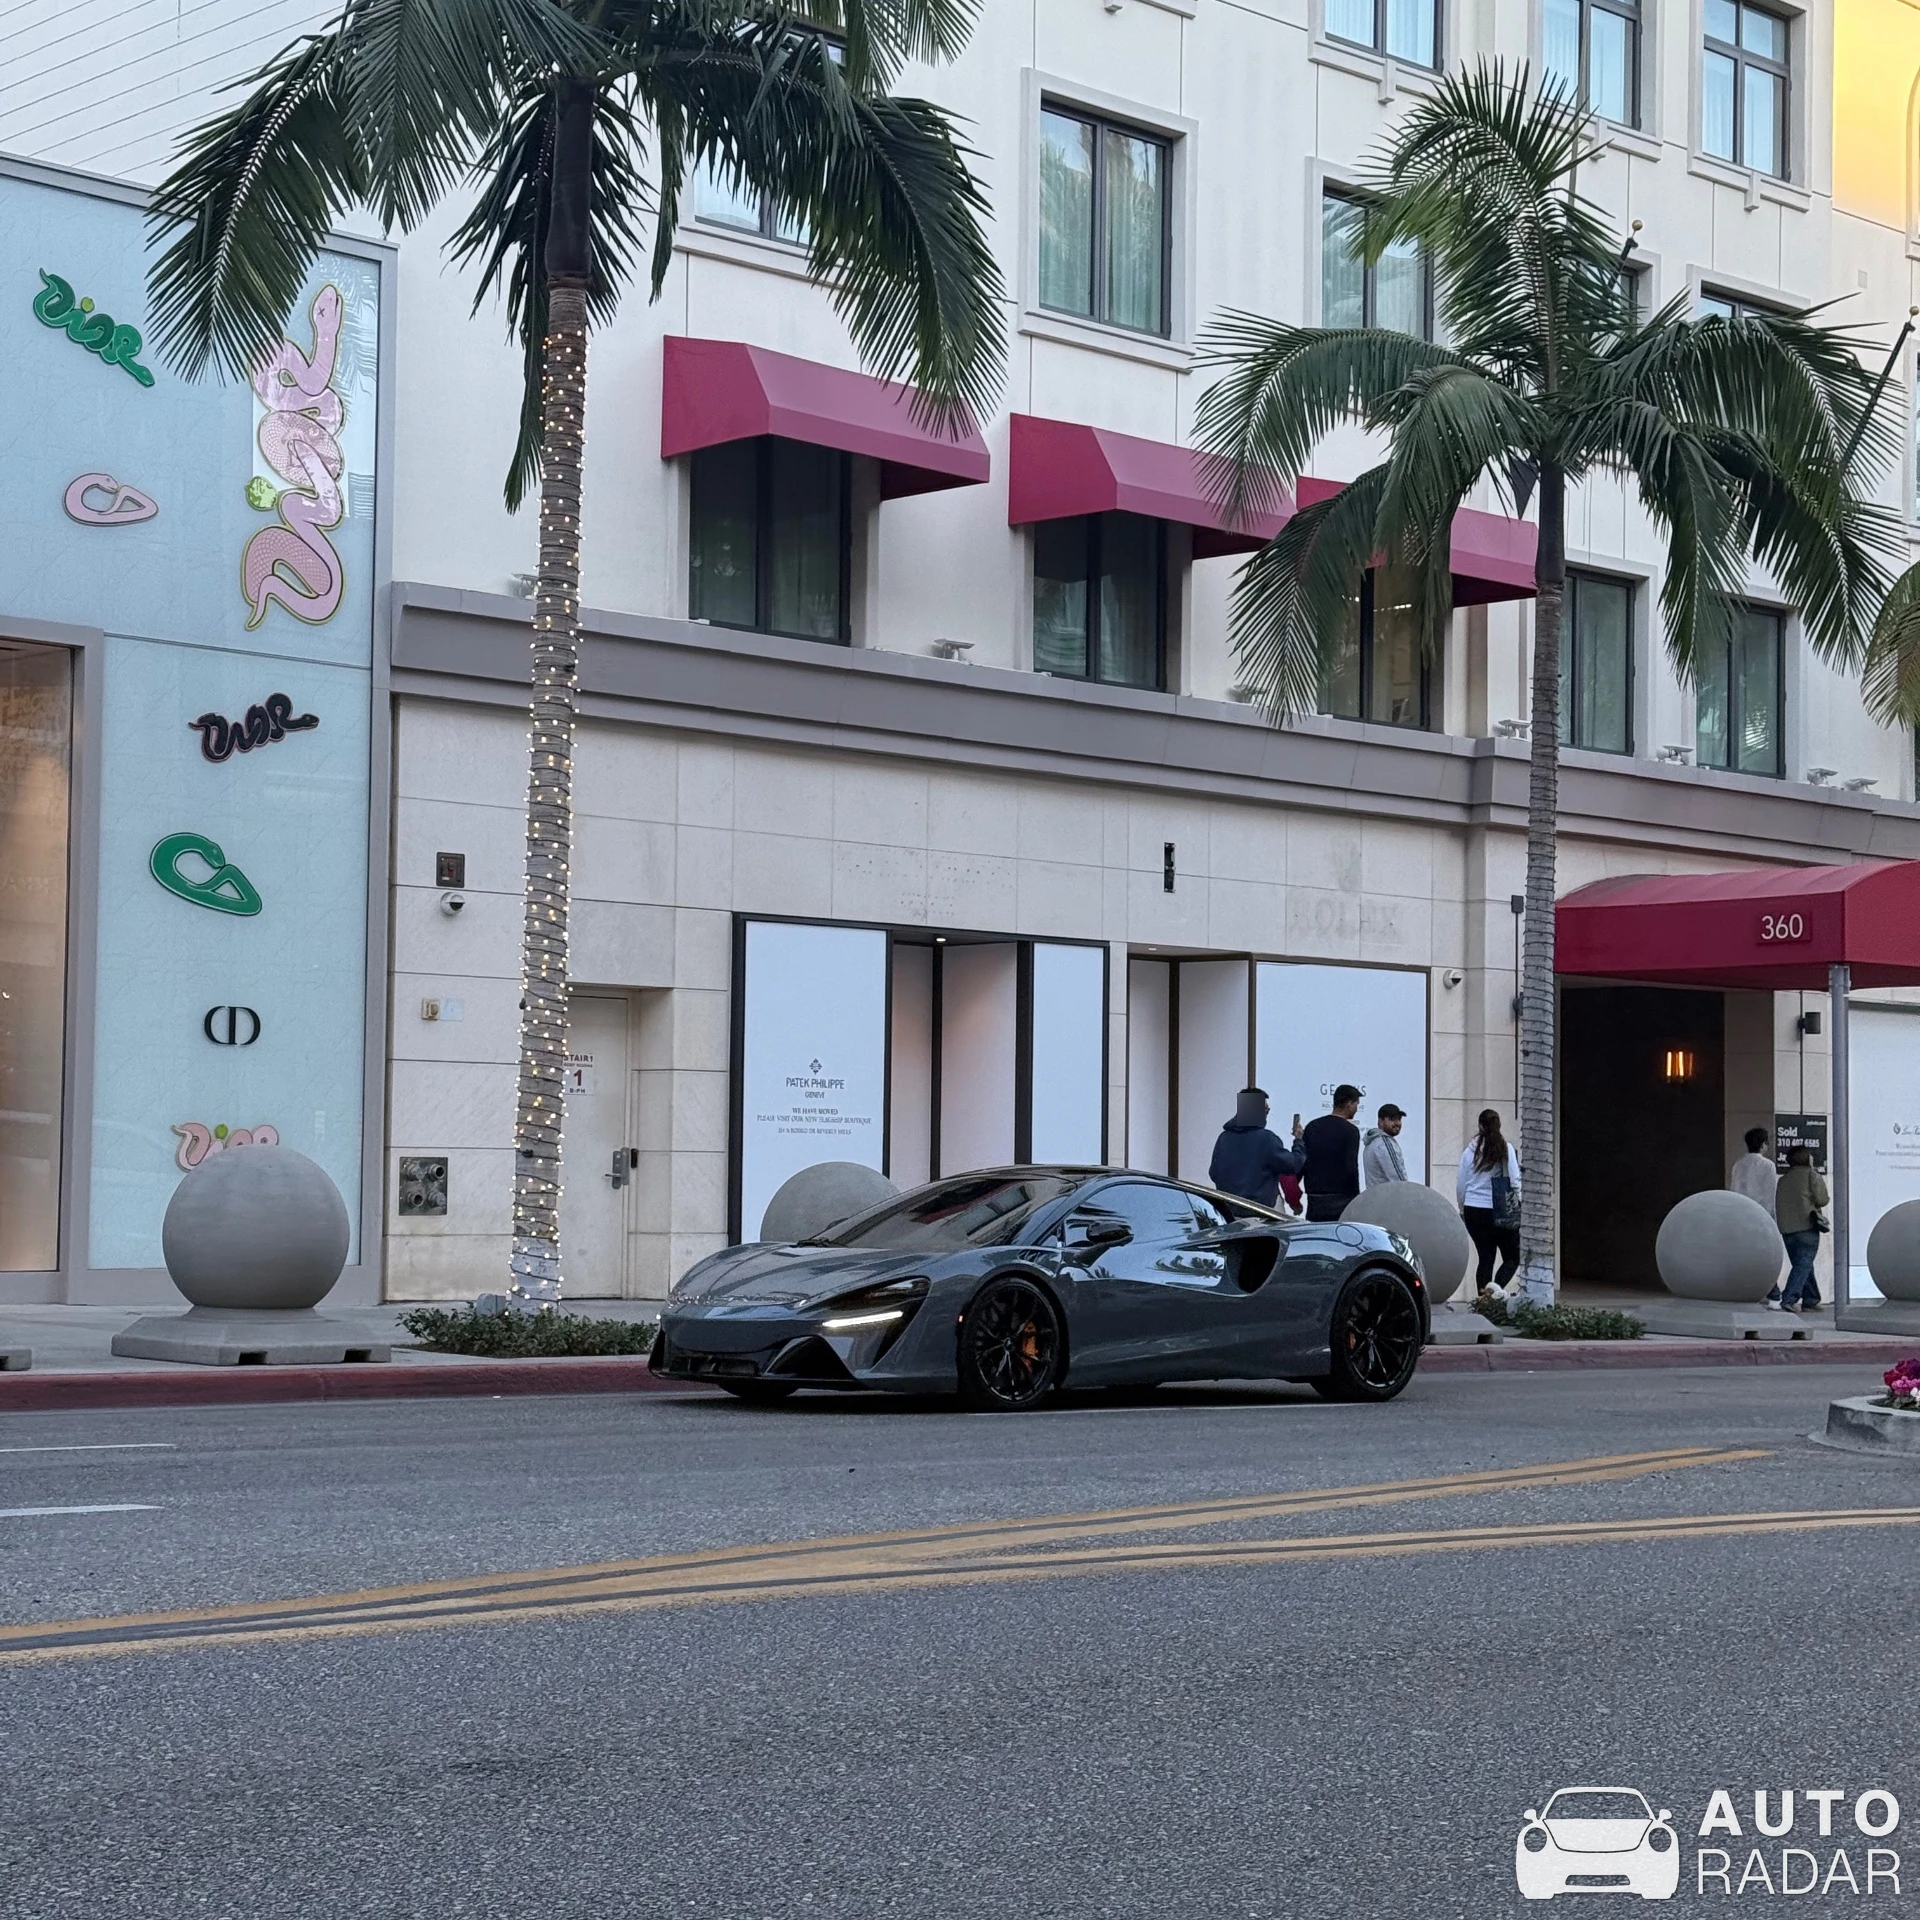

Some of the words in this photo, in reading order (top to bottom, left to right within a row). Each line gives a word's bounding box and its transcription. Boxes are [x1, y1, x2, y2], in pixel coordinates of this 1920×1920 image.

[1760, 913, 1804, 940] 360
[573, 1069, 582, 1086] 1
[786, 1077, 810, 1088] PATEK
[811, 1078, 845, 1090] PHILIPPE
[1320, 1084, 1367, 1097] GES
[802, 1107, 817, 1115] HAVE
[844, 1117, 872, 1126] BOUTIQUE
[1777, 1126, 1798, 1137] Sold
[1777, 1138, 1791, 1147] 310
